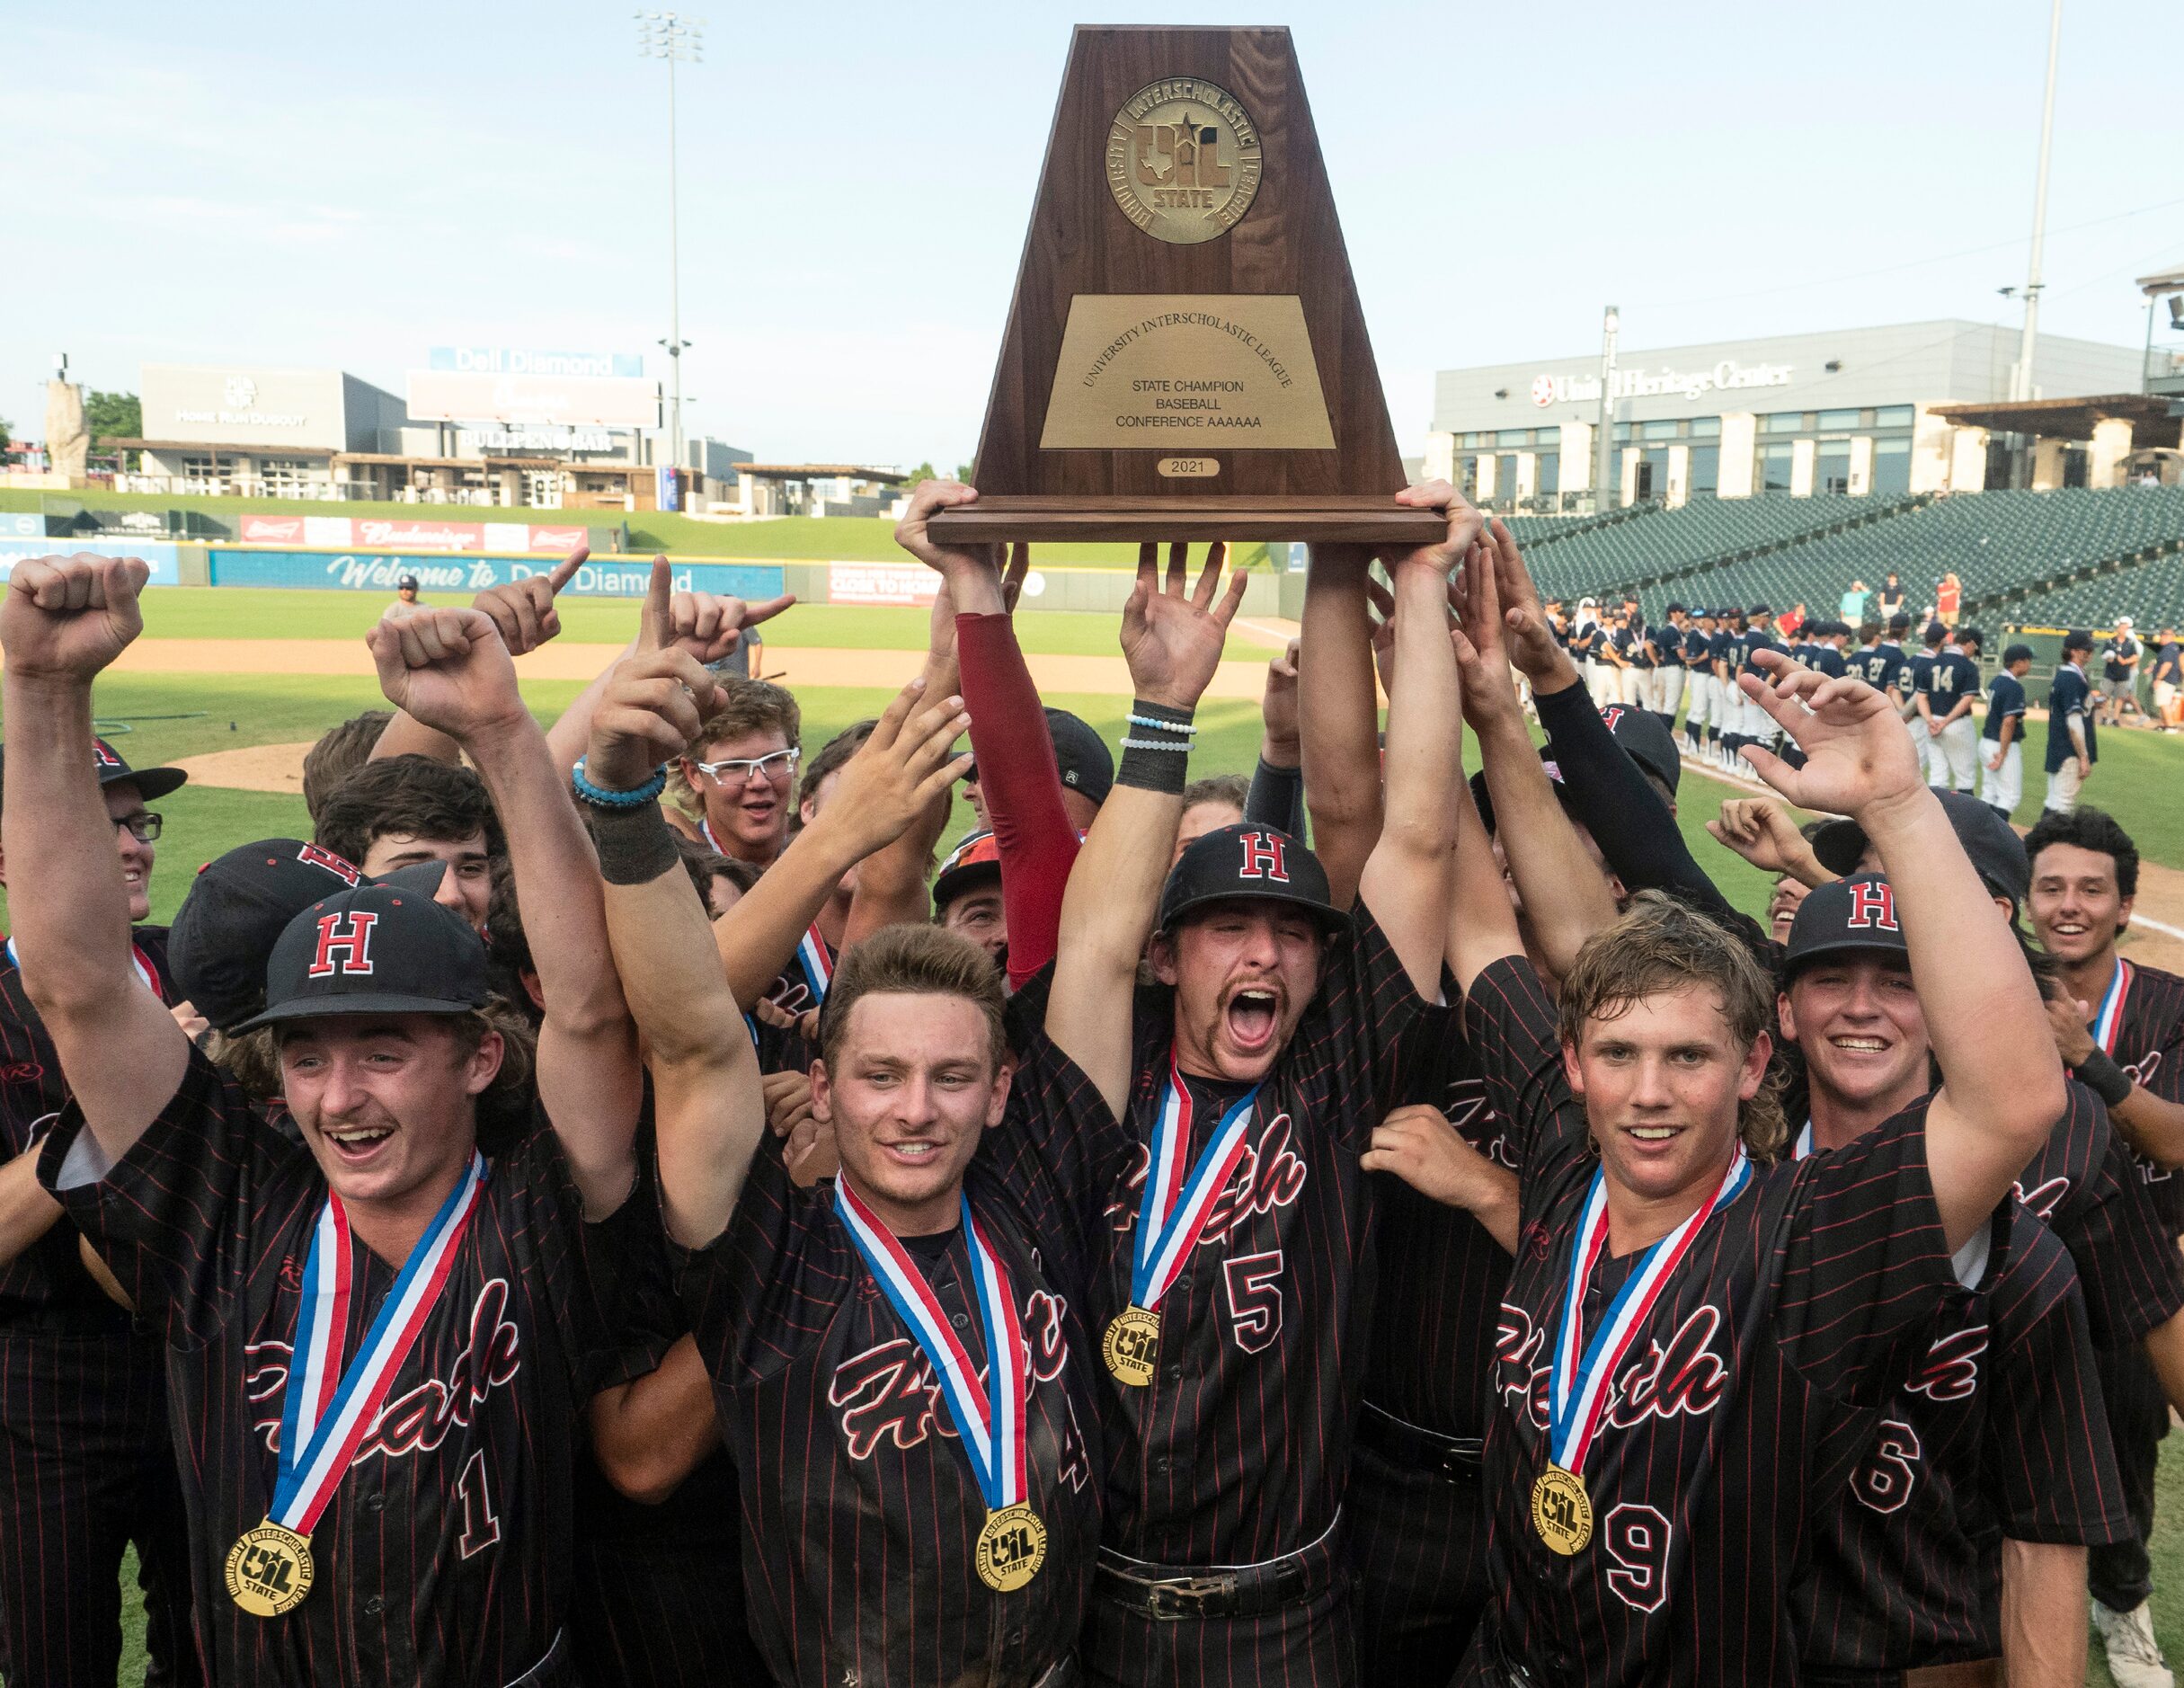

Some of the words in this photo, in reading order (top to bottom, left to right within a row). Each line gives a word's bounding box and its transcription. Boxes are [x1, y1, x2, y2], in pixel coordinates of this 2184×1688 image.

[1125, 79, 1256, 147] INTERSCHOLASTIC
[1219, 163, 1259, 226] LEAGUE
[1153, 189, 1214, 209] STATE
[455, 347, 502, 371] Dell
[509, 349, 614, 377] Diamond
[1082, 325, 1141, 388] UNIVERSITY
[1141, 312, 1257, 348] INTERSCHOLASTIC
[1254, 342, 1293, 389] LEAGUE
[1132, 380, 1170, 392] STATE
[1174, 380, 1244, 393] CHAMPION
[1622, 366, 1712, 400] Heritage
[1713, 360, 1794, 389] Center
[1156, 398, 1221, 410] BASEBALL
[1115, 415, 1203, 428] CONFERENCE
[1206, 416, 1262, 428] AAAAAA
[460, 430, 554, 449] BULLPEN
[572, 433, 613, 451] BAR
[1171, 460, 1205, 473] 2021
[468, 559, 499, 589] to
[1931, 665, 1954, 692] 14
[1239, 831, 1290, 883] H
[1847, 882, 1898, 931] H
[308, 911, 378, 979] H
[1222, 1249, 1283, 1355] 5
[1119, 1356, 1148, 1373] STATE
[1849, 1419, 1921, 1514] 6
[457, 1448, 502, 1560] 1
[1546, 1519, 1570, 1540] STATE
[250, 1529, 311, 1578] INTERSCHOLASTIC
[1000, 1558, 1028, 1577] STATE
[1604, 1503, 1672, 1614] 9
[244, 1579, 279, 1601] STATE
